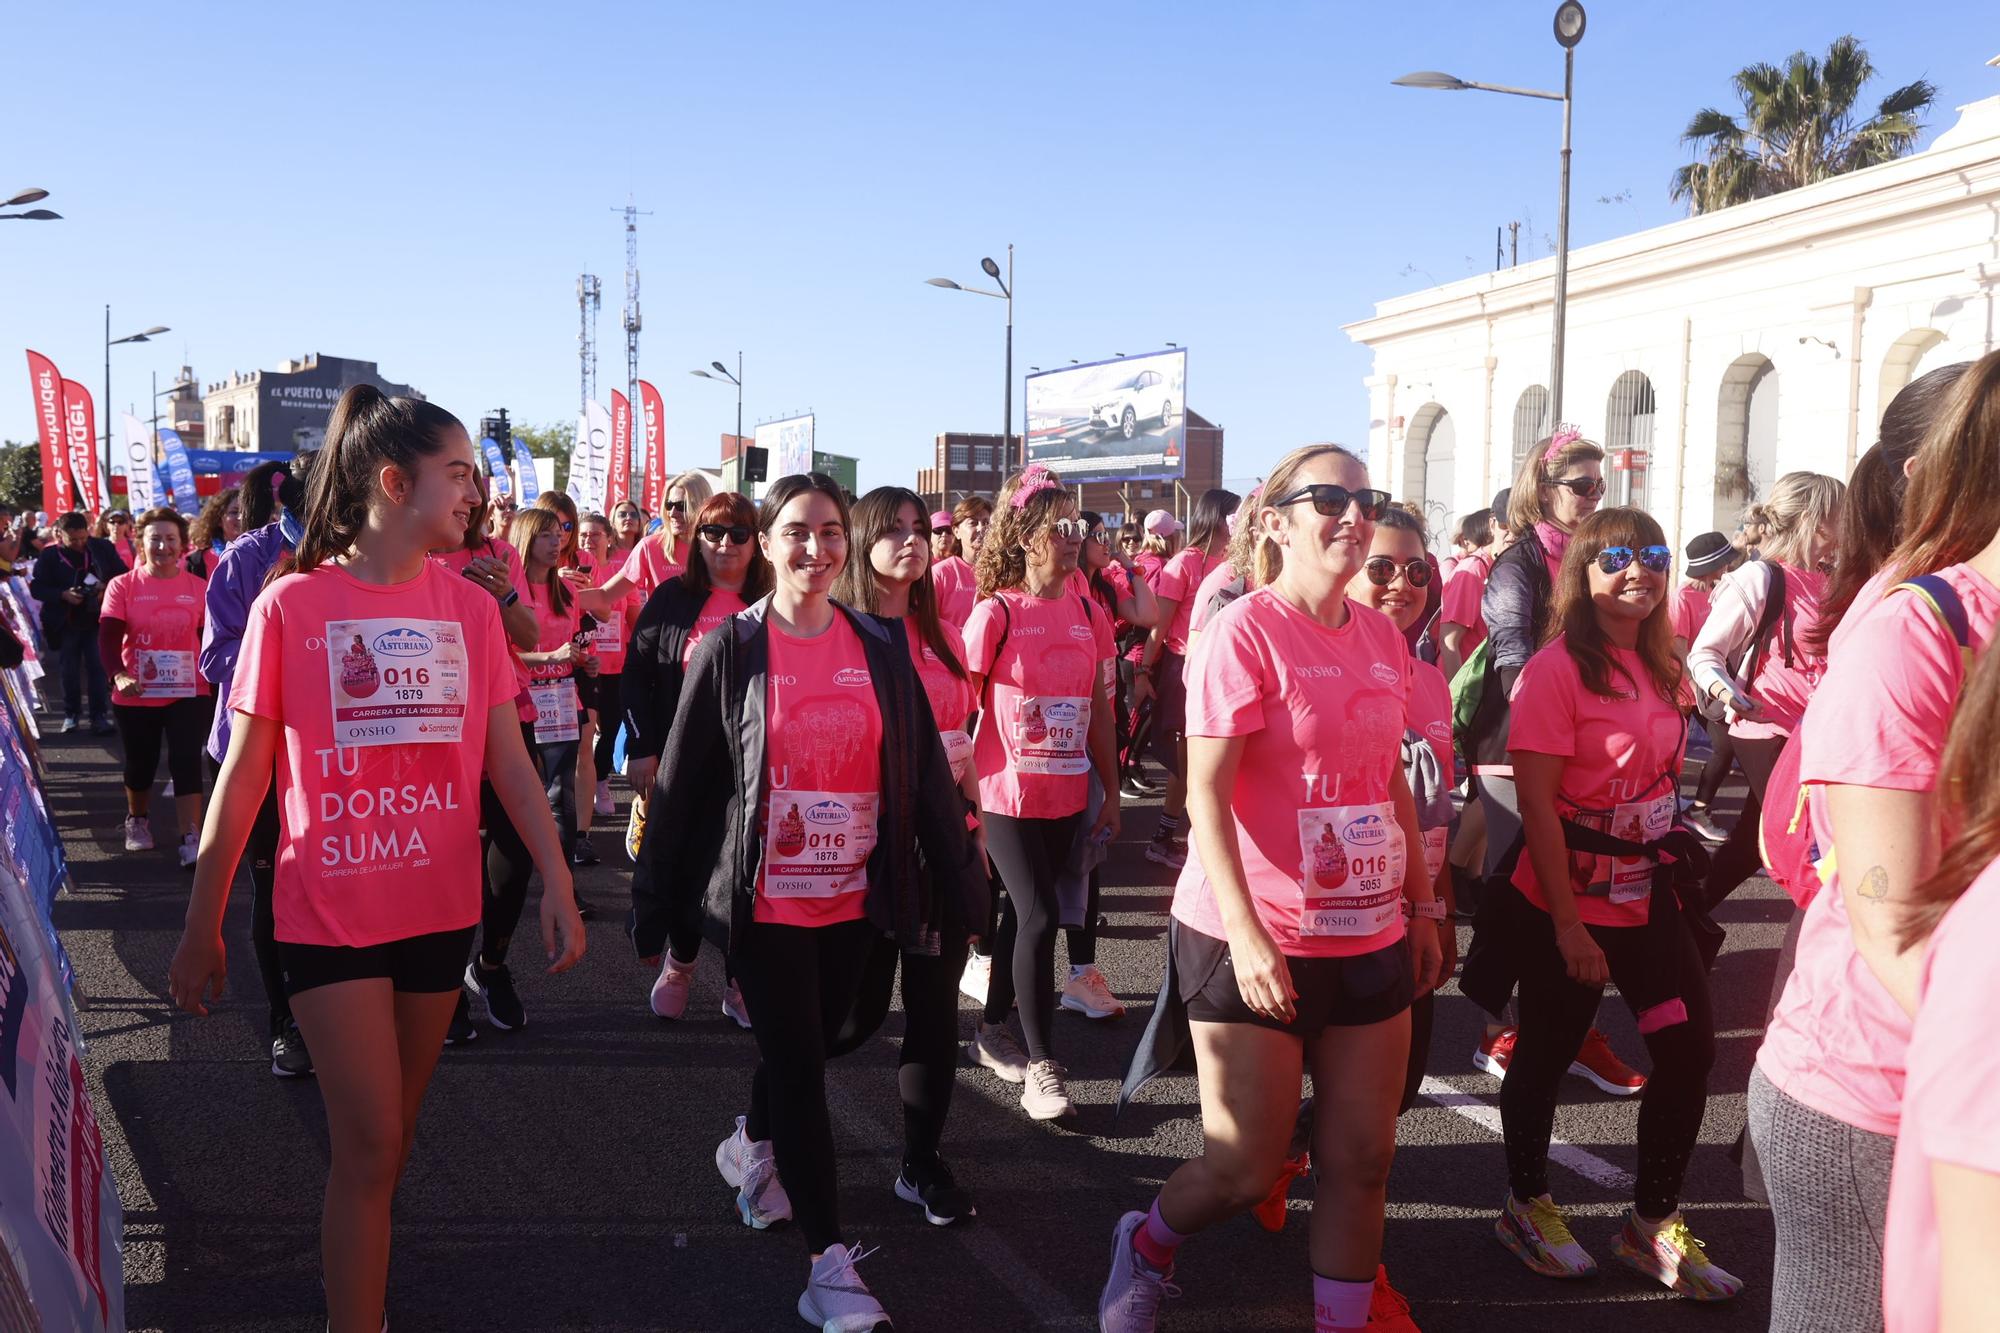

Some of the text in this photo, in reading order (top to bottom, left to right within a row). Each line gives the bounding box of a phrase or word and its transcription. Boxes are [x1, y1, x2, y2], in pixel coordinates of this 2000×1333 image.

[271, 388, 282, 397] EL
[284, 387, 323, 399] PUERTO
[281, 400, 336, 409] Restaurant
[1012, 626, 1045, 637] OYSHO
[379, 640, 429, 650] ASTURIANA
[437, 636, 457, 644] SUMA
[384, 668, 430, 685] 016
[1295, 666, 1342, 678] OYSHO
[395, 689, 423, 700] 1879
[352, 709, 393, 718] CARRERA
[540, 709, 559, 719] 016
[350, 726, 396, 738] OYSHO
[1049, 726, 1073, 739] 016
[1053, 740, 1068, 748] 5049
[314, 747, 359, 778] TU
[1301, 773, 1341, 802] TU
[1608, 778, 1638, 800] TU
[321, 782, 459, 822] DORSAL
[809, 808, 848, 819] ASTURIANA
[809, 833, 846, 847] 016
[321, 827, 428, 866] SUMA
[815, 851, 838, 861] 1878
[321, 867, 358, 878] CARRERA
[378, 862, 404, 872] MUJER
[412, 858, 431, 868] 2023
[780, 866, 812, 874] CARRERA
[1352, 855, 1387, 876] 016
[776, 881, 812, 890] OYSHO
[1360, 878, 1382, 891] 5053
[1320, 899, 1357, 907] CARRERA
[1360, 898, 1370, 906] DE
[1314, 916, 1357, 926] OYSHO
